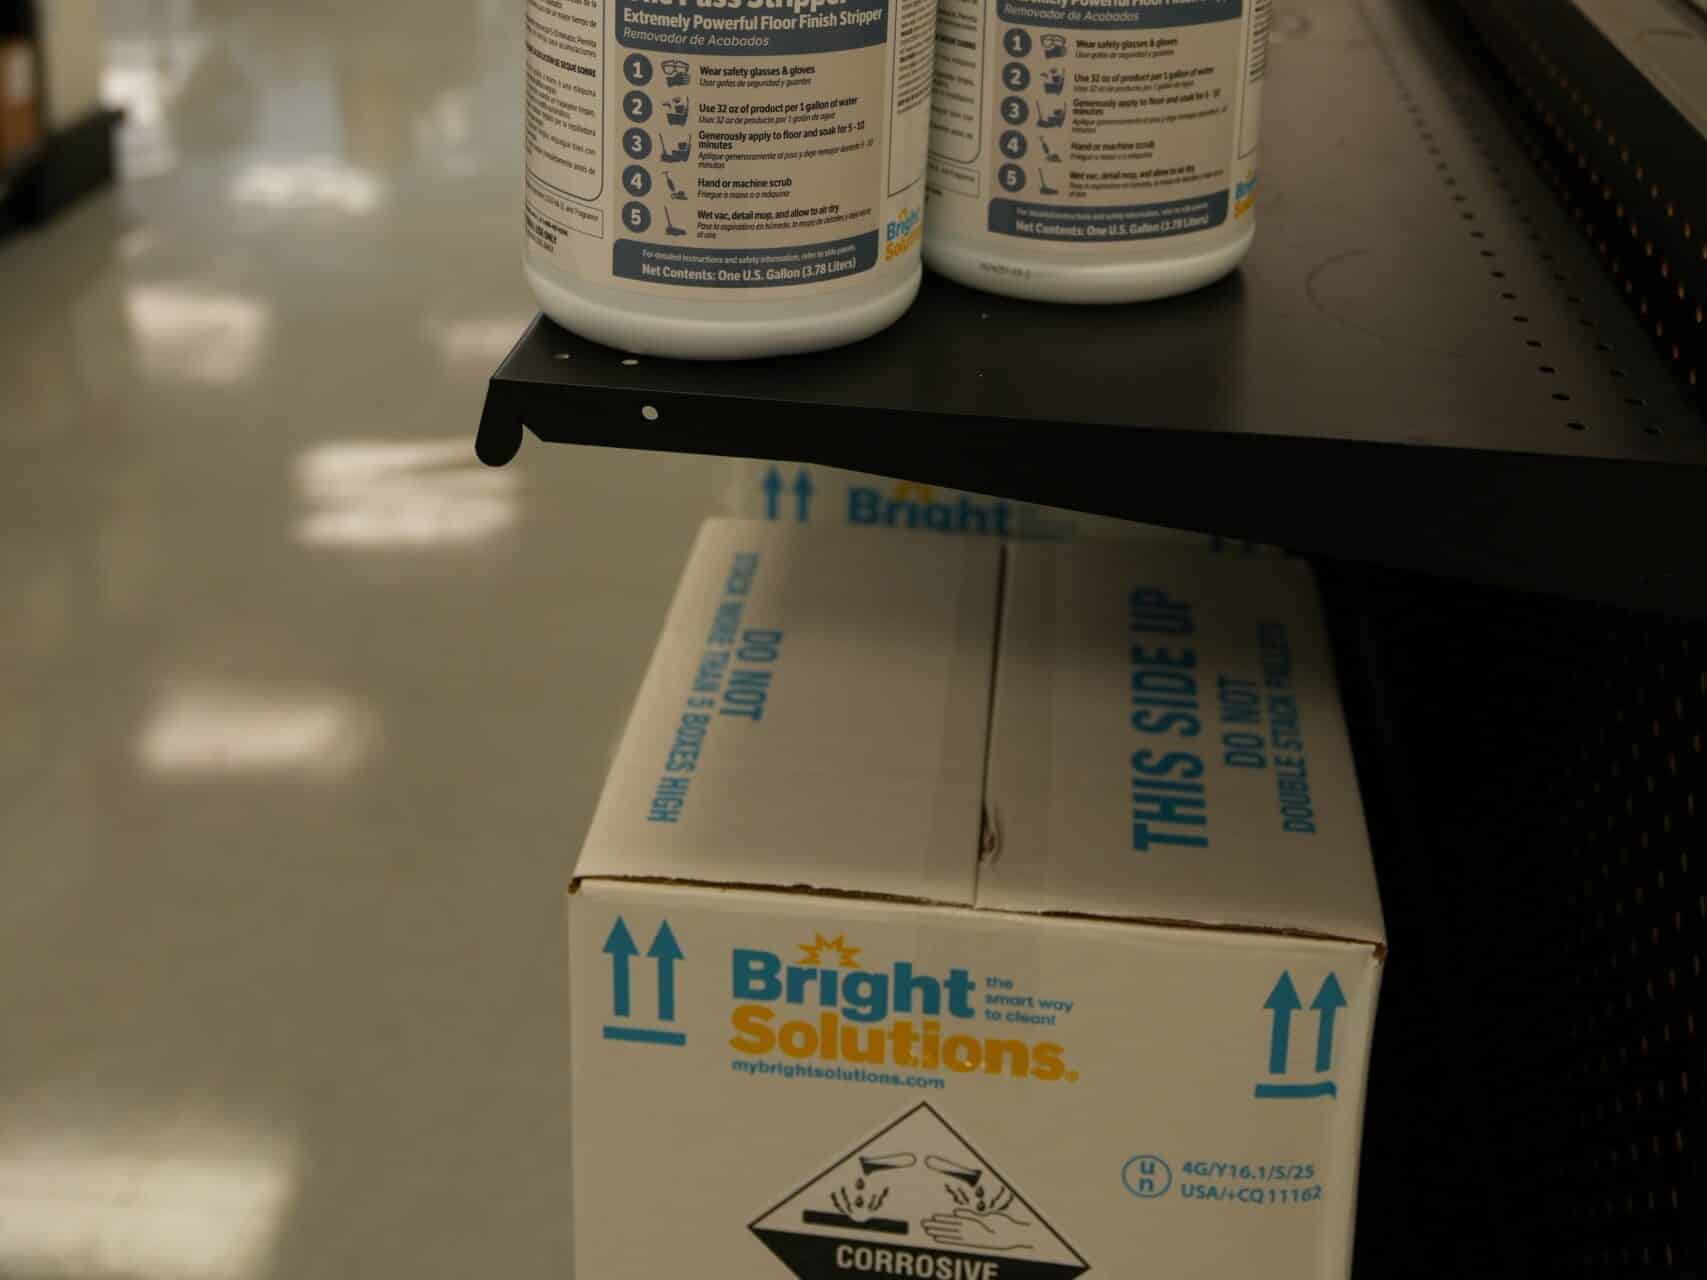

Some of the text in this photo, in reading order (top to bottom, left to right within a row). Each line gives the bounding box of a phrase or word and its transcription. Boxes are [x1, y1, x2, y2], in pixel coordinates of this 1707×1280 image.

[623, 7, 882, 32] Extremely Powerful Floor Finish Stripper
[623, 26, 769, 47] Removador de Acabados
[1012, 36, 1022, 51] 1
[633, 62, 643, 78] 1
[700, 65, 815, 79] Wear safety glasses & gloves
[1011, 71, 1021, 84] 2
[631, 99, 642, 115] 2
[700, 104, 715, 113] Use
[717, 104, 727, 113] 32
[740, 104, 749, 113] of
[751, 104, 784, 115] product
[785, 104, 799, 115] per
[800, 102, 804, 111] 1
[806, 100, 829, 112] gallon
[830, 99, 838, 108] of
[839, 96, 858, 106] water
[1009, 103, 1019, 117] 3
[699, 130, 746, 142] Generously
[749, 131, 770, 142] apply
[773, 131, 781, 139] to
[783, 129, 801, 139] floor
[803, 128, 817, 138] and
[819, 126, 835, 136] soak
[837, 124, 846, 133] for
[631, 136, 642, 151] 3
[699, 141, 733, 150] minutes
[1007, 137, 1019, 152] 4
[630, 173, 642, 189] 4
[698, 177, 792, 188] Hand or machine scrub
[1006, 171, 1016, 185] 5
[631, 209, 641, 224] 5
[698, 210, 714, 219] Wet
[732, 210, 753, 220] detail
[776, 210, 789, 219] and
[790, 208, 810, 217] allow
[811, 208, 818, 216] to
[1015, 221, 1035, 232] Net
[1087, 225, 1107, 236] One
[1109, 224, 1129, 236] U.S.
[1129, 223, 1159, 235] Gallon
[642, 257, 857, 282] Net Contents: One U.S. Gallon (3.78 Liters)
[848, 486, 1011, 535] Bright
[736, 628, 783, 662] DO
[719, 669, 773, 723] NOT
[1129, 584, 1209, 852] THIS SIDE UP
[1216, 672, 1268, 769] DO NOT
[666, 712, 710, 772] BOXES
[648, 776, 690, 823] HIGH
[1274, 753, 1317, 834] DOUBLE
[732, 948, 976, 1023] Bright
[986, 975, 1014, 990] the
[985, 992, 1074, 1013] smart way
[984, 1008, 1057, 1027] to clean!
[729, 1004, 1068, 1083] Solutions
[731, 1058, 946, 1090] mybrightsolutions.com
[835, 1244, 1001, 1280] CORROSIVE
